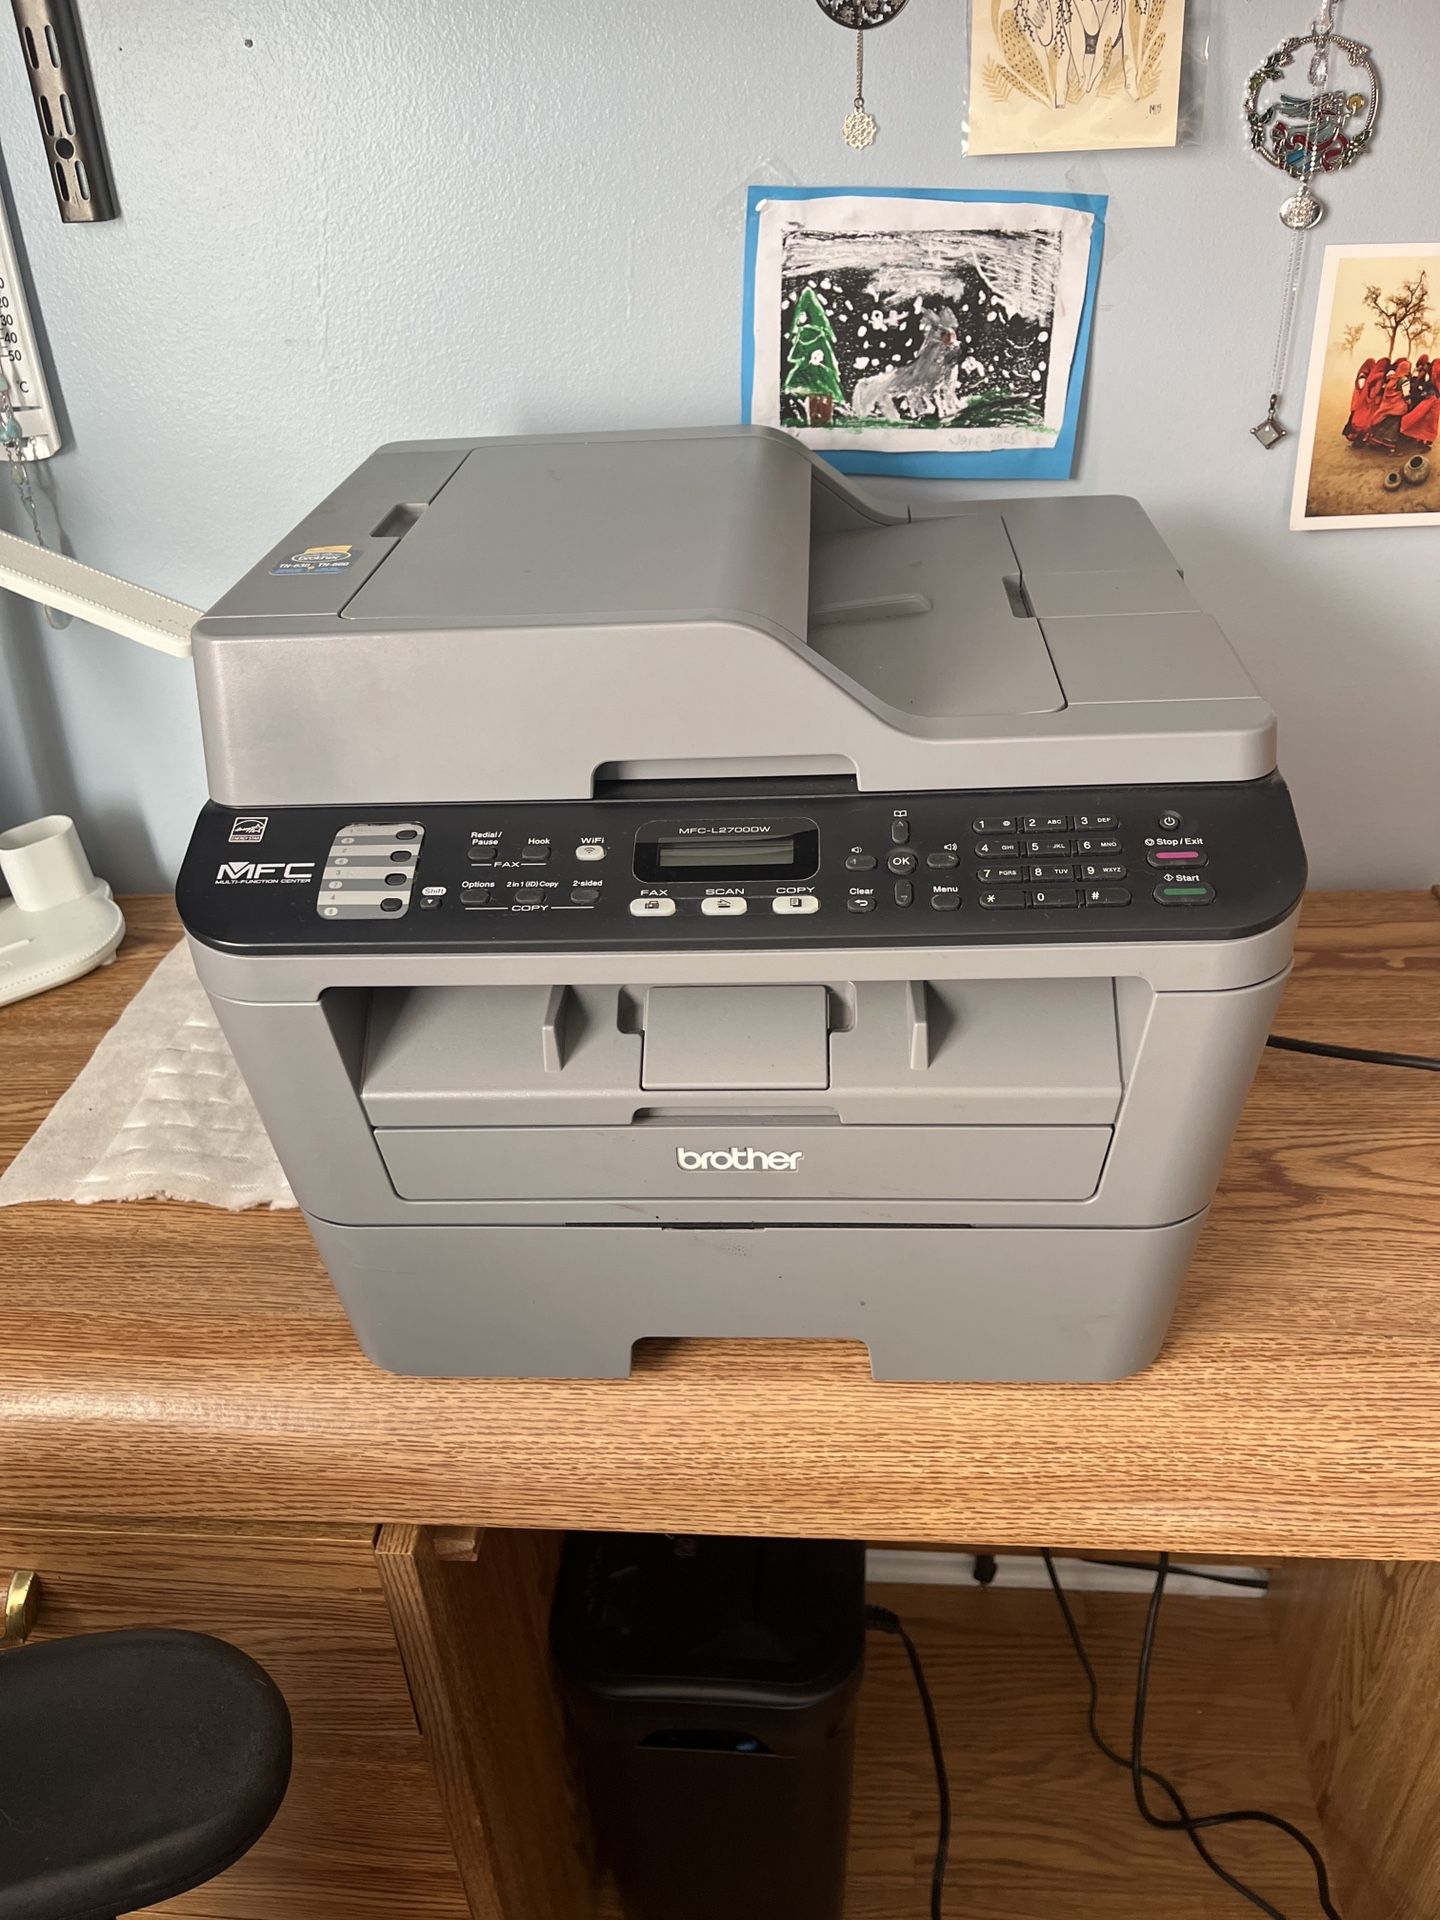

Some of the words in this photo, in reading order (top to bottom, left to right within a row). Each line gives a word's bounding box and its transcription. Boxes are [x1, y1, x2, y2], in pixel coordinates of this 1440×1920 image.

[0, 314, 14, 326] 30
[4, 332, 18, 344] 40
[8, 350, 22, 362] 50
[979, 820, 986, 829] 1
[1028, 819, 1037, 827] 2
[1081, 817, 1089, 825] 3
[678, 826, 772, 835] MFC-L2700DW
[981, 844, 989, 852] 4
[1032, 843, 1039, 851] 5
[892, 857, 911, 866] OK
[216, 862, 316, 880] MFC
[984, 870, 991, 878] 7
[1035, 868, 1043, 877] 8
[1087, 866, 1095, 875] 9
[1176, 874, 1200, 882] Start
[462, 881, 495, 889] Options
[1037, 893, 1045, 901] 0
[1091, 892, 1100, 900] #
[677, 1148, 803, 1170] brother
